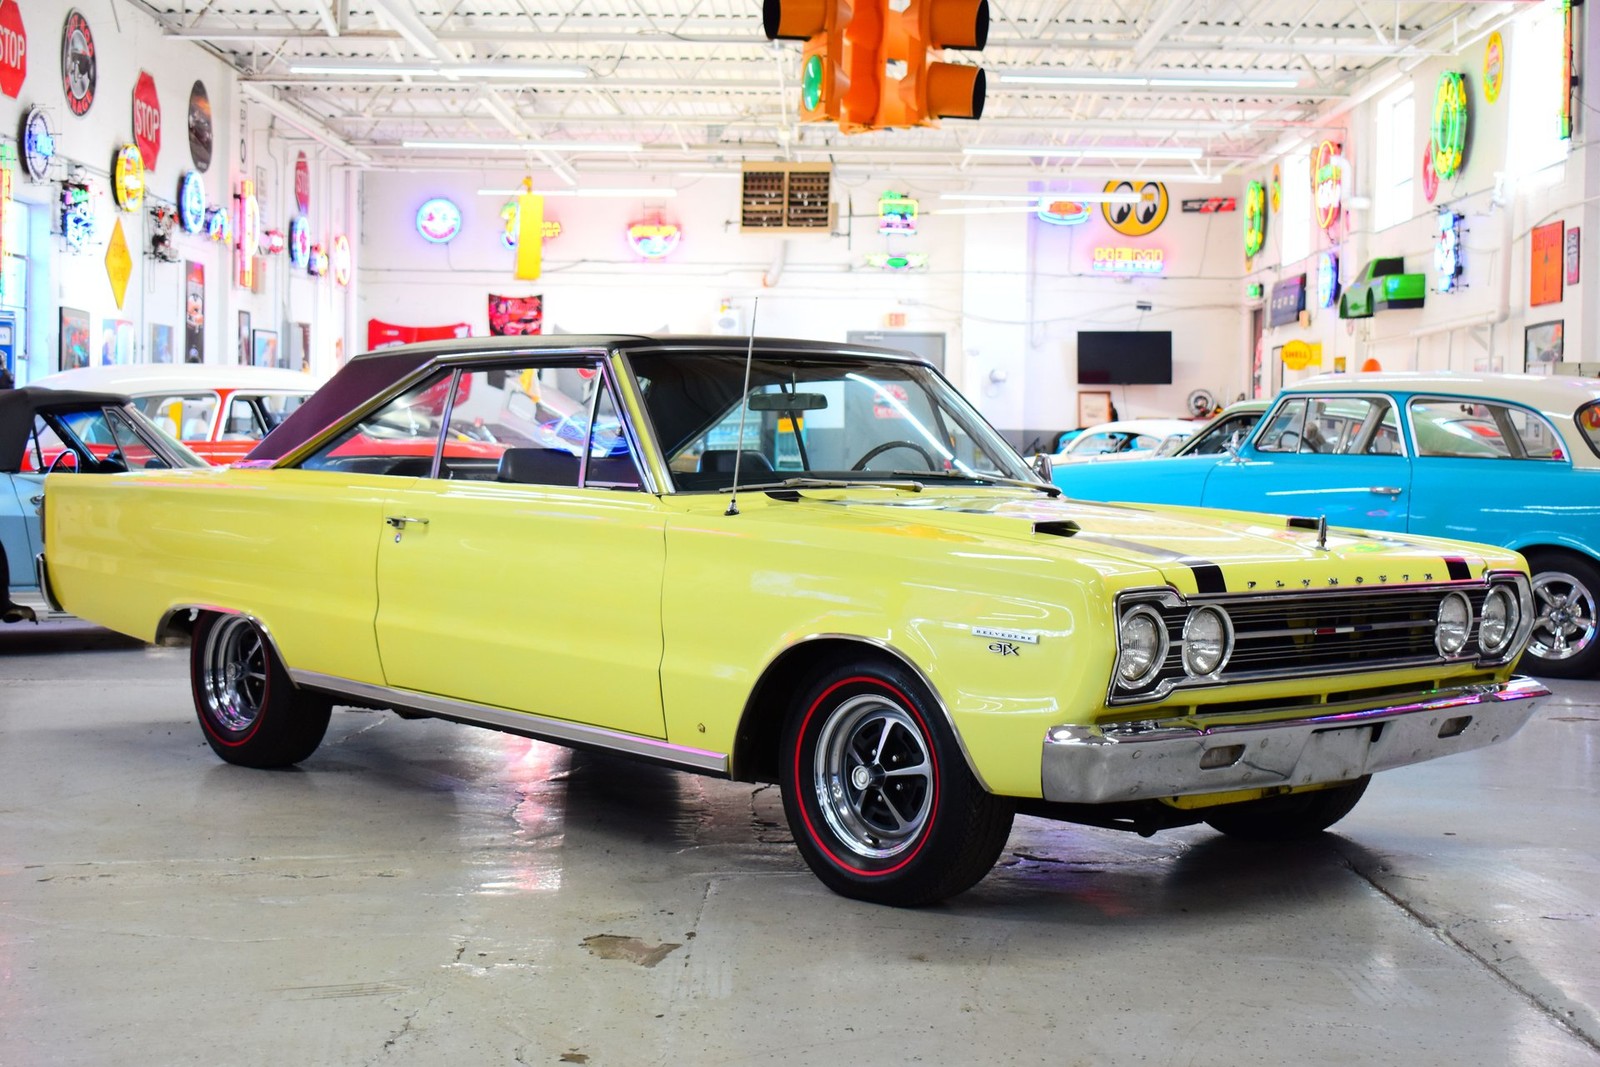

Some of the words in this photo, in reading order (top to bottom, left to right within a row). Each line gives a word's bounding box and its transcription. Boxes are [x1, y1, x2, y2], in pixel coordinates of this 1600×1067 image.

[136, 98, 160, 143] STOP
[1284, 350, 1308, 359] SHELL
[1247, 573, 1433, 589] PLYMOUTH
[976, 629, 1032, 641] BELVEDERE
[987, 640, 1020, 656] GTX
